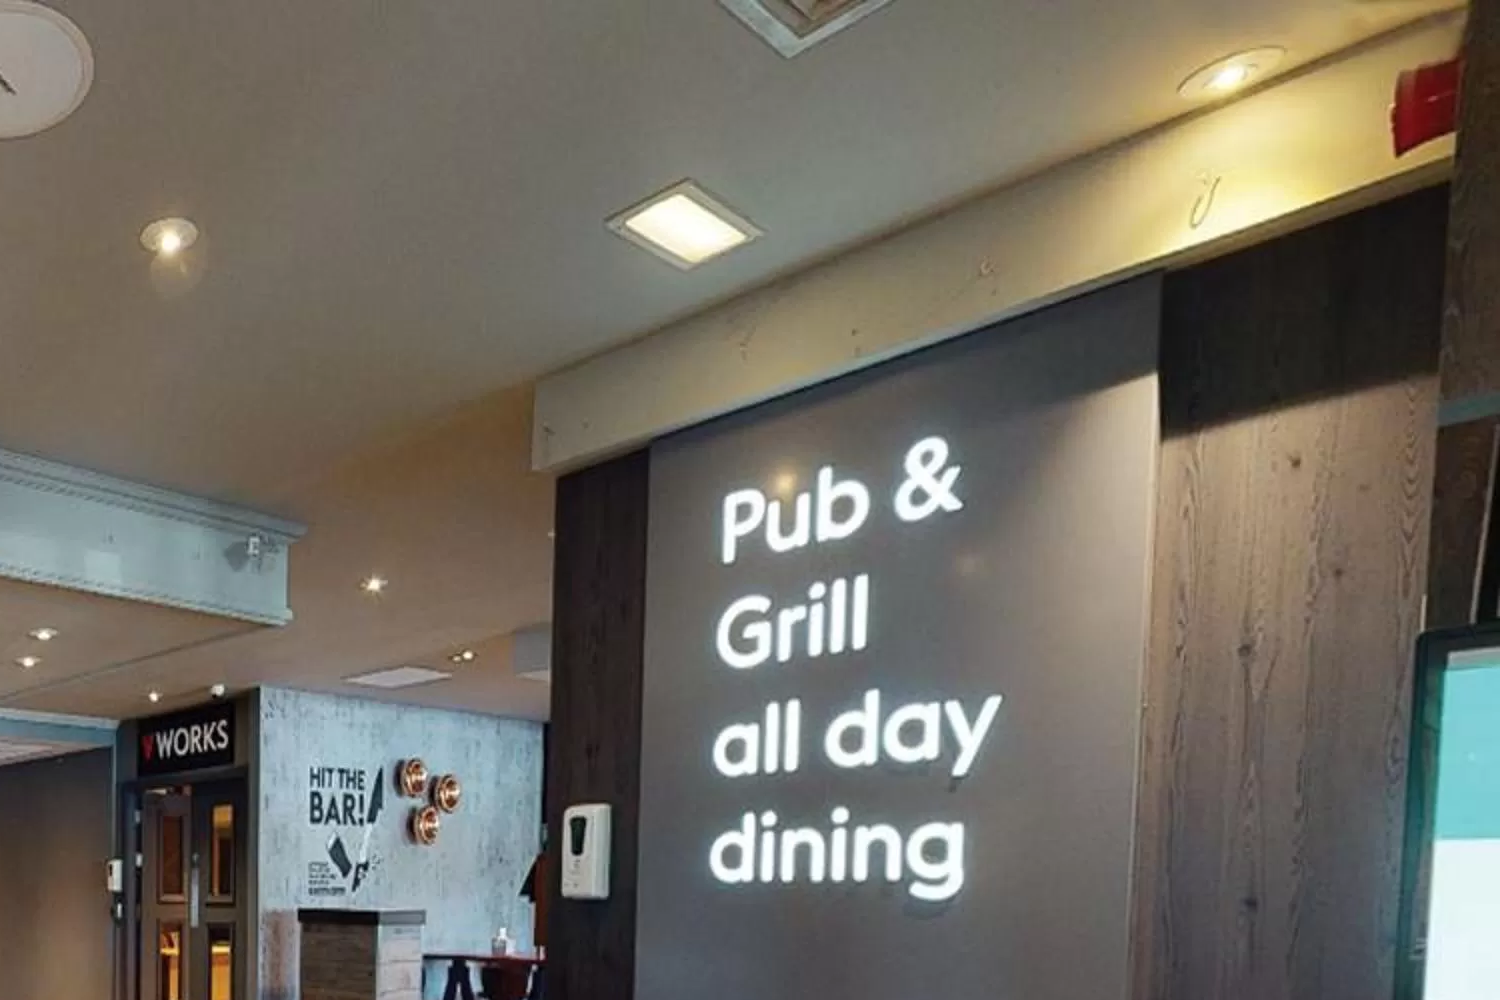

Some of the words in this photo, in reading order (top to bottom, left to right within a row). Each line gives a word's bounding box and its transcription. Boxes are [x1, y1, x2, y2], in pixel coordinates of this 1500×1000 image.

[721, 465, 871, 564] Pub
[894, 436, 964, 523] &
[716, 573, 869, 669] Grill
[309, 766, 335, 789] HIT
[338, 767, 365, 791] THE
[712, 699, 801, 777] all
[824, 688, 1003, 777] day
[309, 791, 365, 826] BAR!
[709, 806, 966, 902] dining
